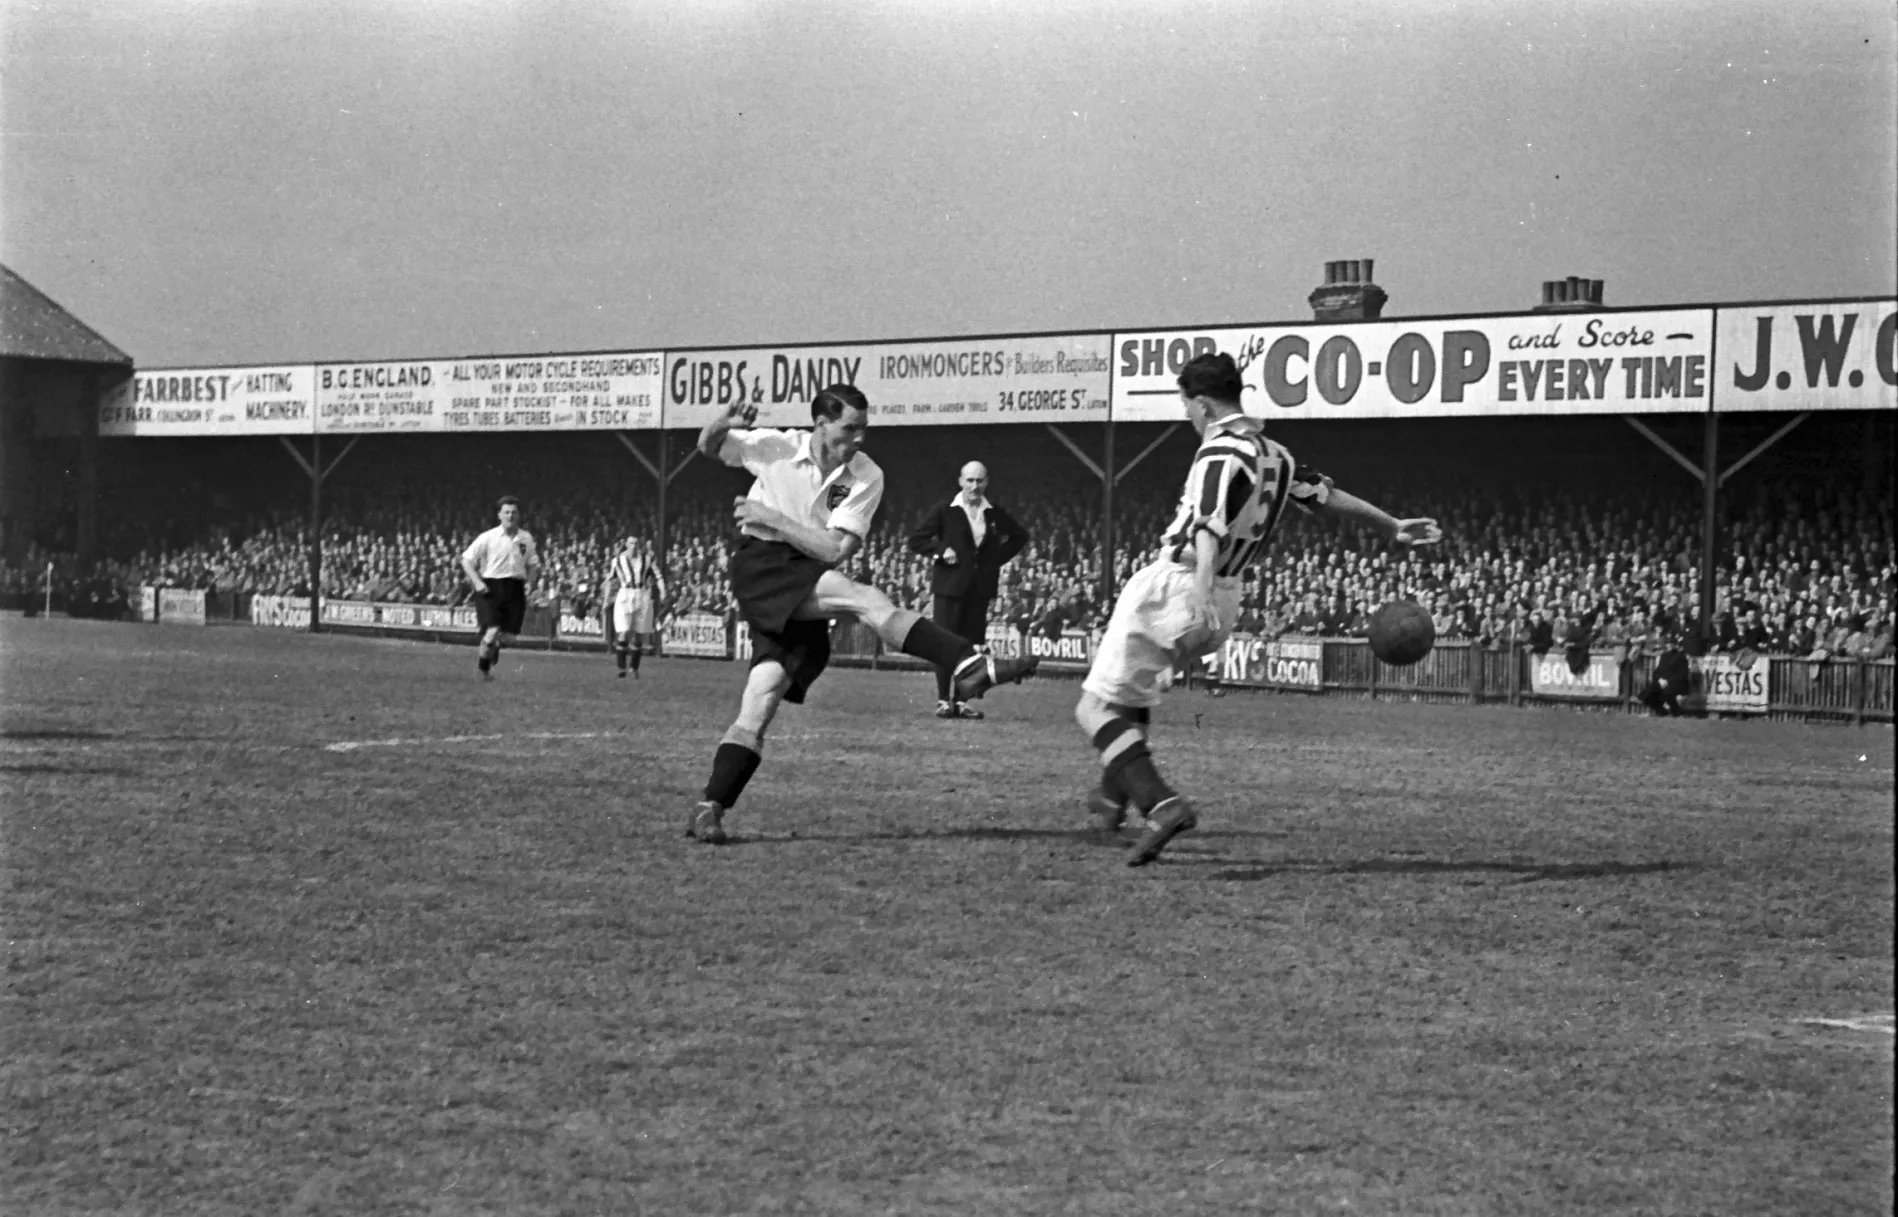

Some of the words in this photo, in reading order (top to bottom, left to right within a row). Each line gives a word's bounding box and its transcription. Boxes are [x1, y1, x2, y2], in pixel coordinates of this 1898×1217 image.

[1508, 323, 1560, 350] and
[1578, 319, 1655, 348] Score
[452, 364, 471, 381] ALL
[473, 363, 501, 380] YOUR
[505, 362, 543, 379] MOTOR
[546, 360, 578, 378] CYCLE
[581, 358, 660, 377] REQUIREMENTS
[879, 351, 1004, 379] IRONMONGERS
[1263, 330, 1491, 408] CO-OP
[1499, 357, 1613, 401] EVERY
[1622, 354, 1706, 399] TIME
[491, 382, 512, 394] NEW
[517, 382, 538, 393] AND
[543, 380, 611, 393] SECONDHAND
[671, 357, 748, 405] GIBBS
[772, 354, 861, 403] DANDY
[452, 397, 481, 409] SPARE
[570, 395, 589, 408] FOR
[593, 395, 613, 407] ALL
[616, 394, 651, 407] MAKES
[1018, 389, 1066, 411] GEORGE
[443, 411, 469, 426] TYRES
[504, 411, 552, 425] BATTERIES
[591, 409, 629, 424] STOCK
[1031, 636, 1087, 659] BOVRIL
[1267, 657, 1320, 686] COCOA
[1539, 662, 1611, 686] BOVIL
[1705, 669, 1763, 696] VESTAS
